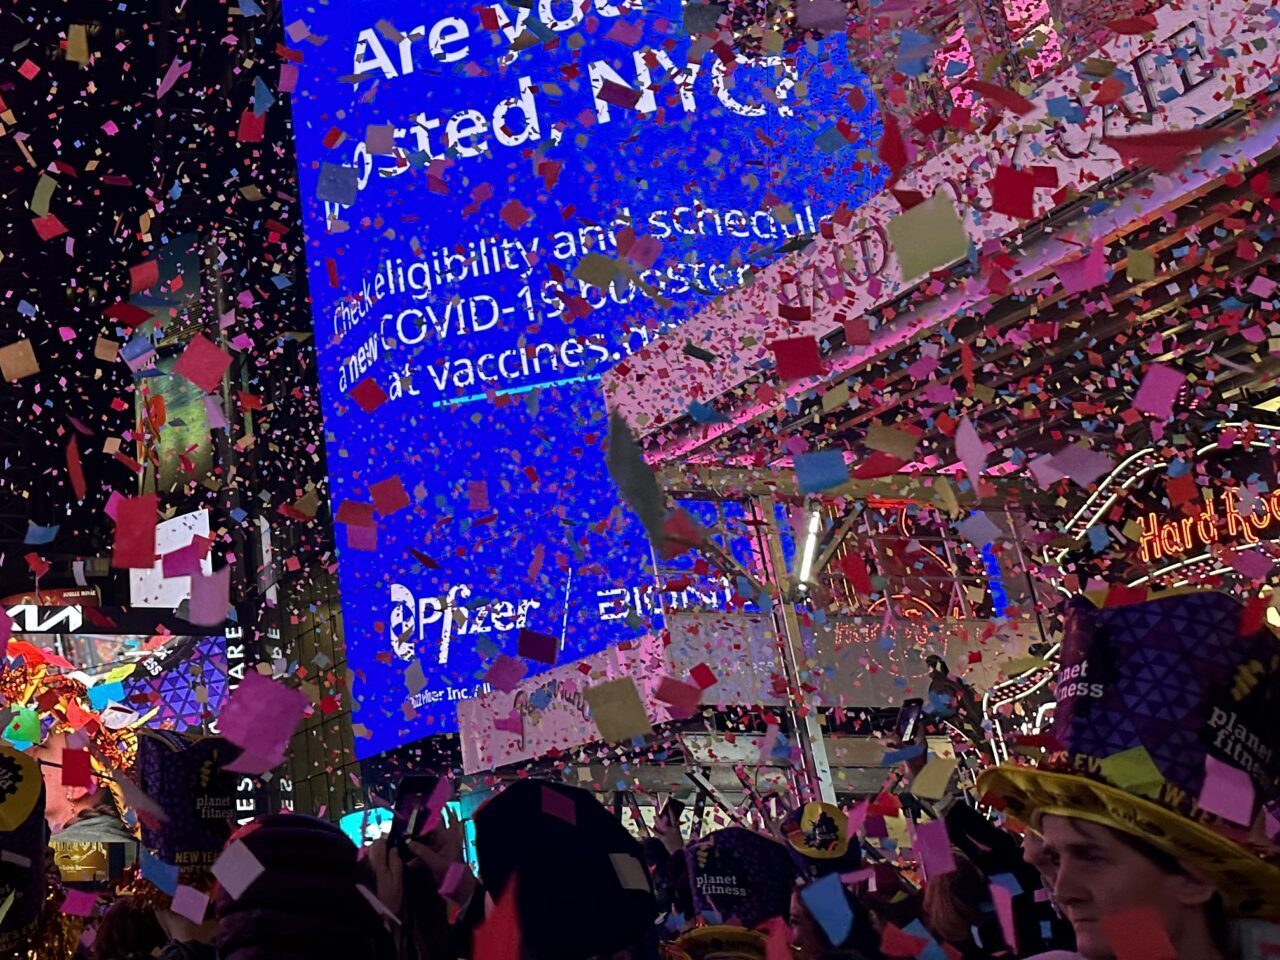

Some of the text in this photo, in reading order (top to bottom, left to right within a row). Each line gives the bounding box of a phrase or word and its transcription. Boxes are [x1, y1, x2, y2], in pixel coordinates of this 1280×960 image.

[353, 16, 470, 92] Are
[374, 236, 540, 300] eligibility
[338, 279, 566, 393] a new COVID-19
[388, 362, 420, 401] at
[1136, 498, 1218, 562] Hard
[446, 686, 472, 701] Inc.
[196, 794, 231, 809] planet
[696, 874, 738, 888] planet
[702, 883, 747, 897] fitness
